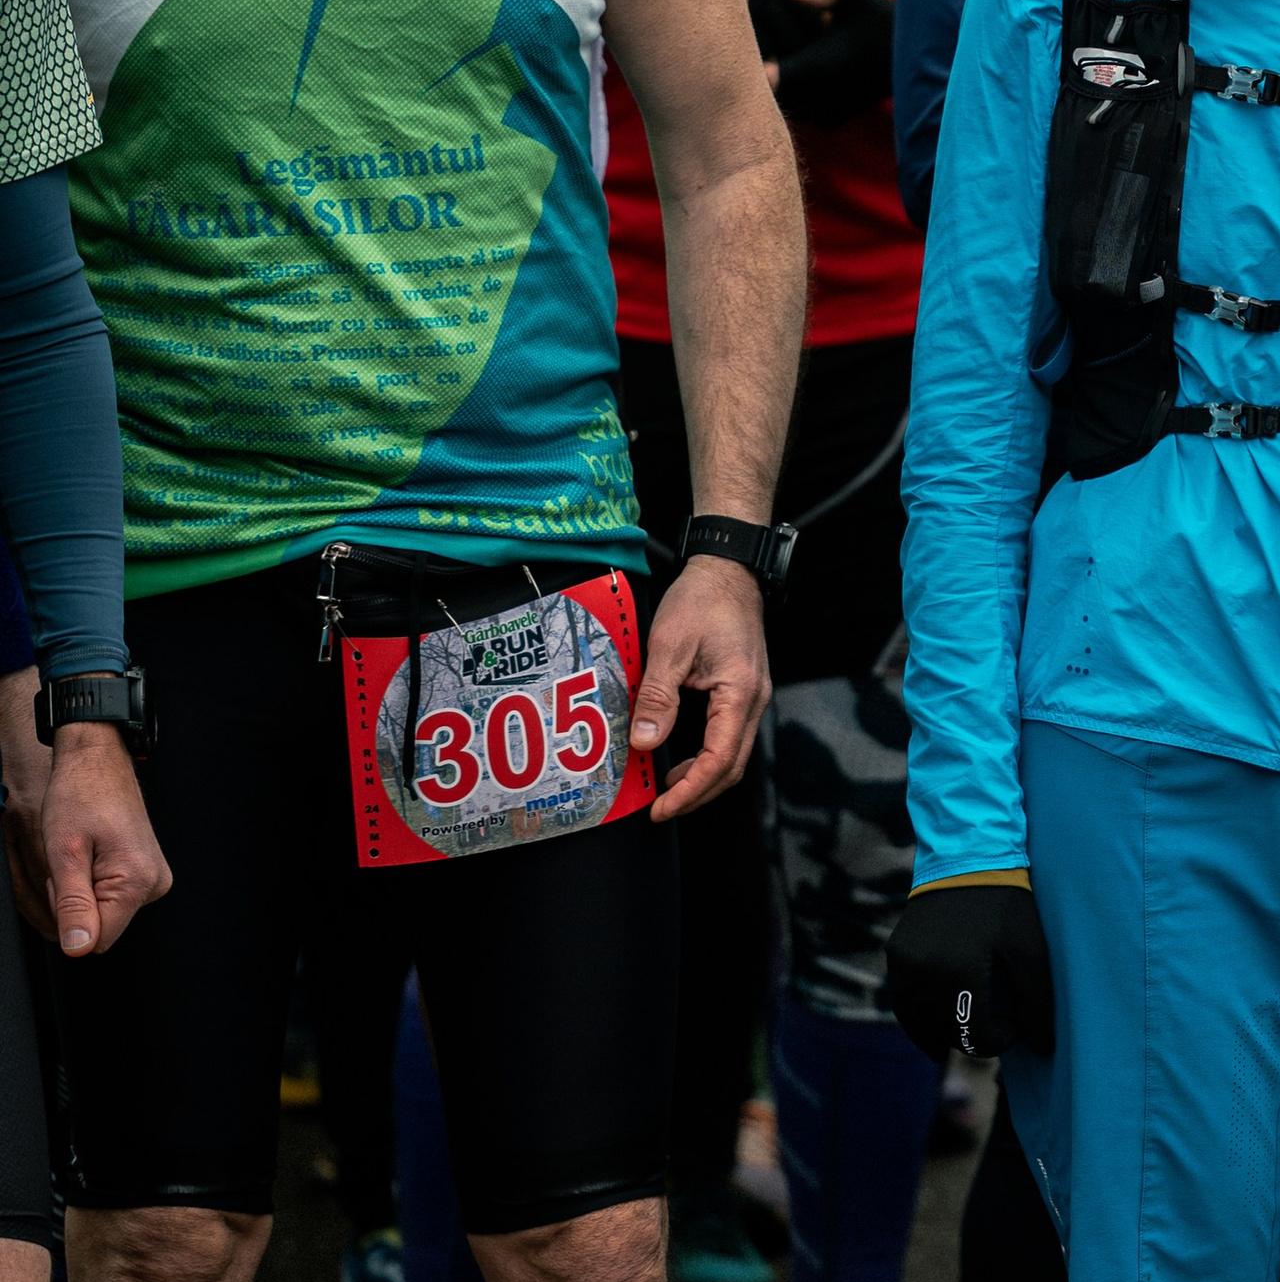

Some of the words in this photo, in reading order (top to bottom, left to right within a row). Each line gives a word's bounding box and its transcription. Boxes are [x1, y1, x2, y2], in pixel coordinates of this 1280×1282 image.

[235, 133, 487, 196] Legământul
[126, 191, 465, 246] FĂGĂRAȘILOR
[470, 246, 486, 266] al
[401, 280, 473, 302] vrednic
[481, 274, 501, 293] de
[340, 318, 366, 333] cu
[467, 305, 490, 325] de
[311, 343, 385, 362] Promit
[388, 339, 411, 359] să
[455, 340, 479, 356] cu
[328, 370, 362, 390] mă
[376, 370, 420, 393] port
[435, 371, 462, 386] cu
[373, 444, 406, 462] voi
[463, 611, 539, 645] Gârboavele
[491, 625, 545, 657] RUN
[483, 649, 499, 669] &
[491, 644, 549, 681] RIDE
[356, 663, 369, 729] TRAIL
[363, 749, 373, 786] RUN
[414, 666, 610, 808] 305
[526, 787, 582, 812] maus
[421, 817, 485, 838] Powered
[486, 813, 507, 831] by
